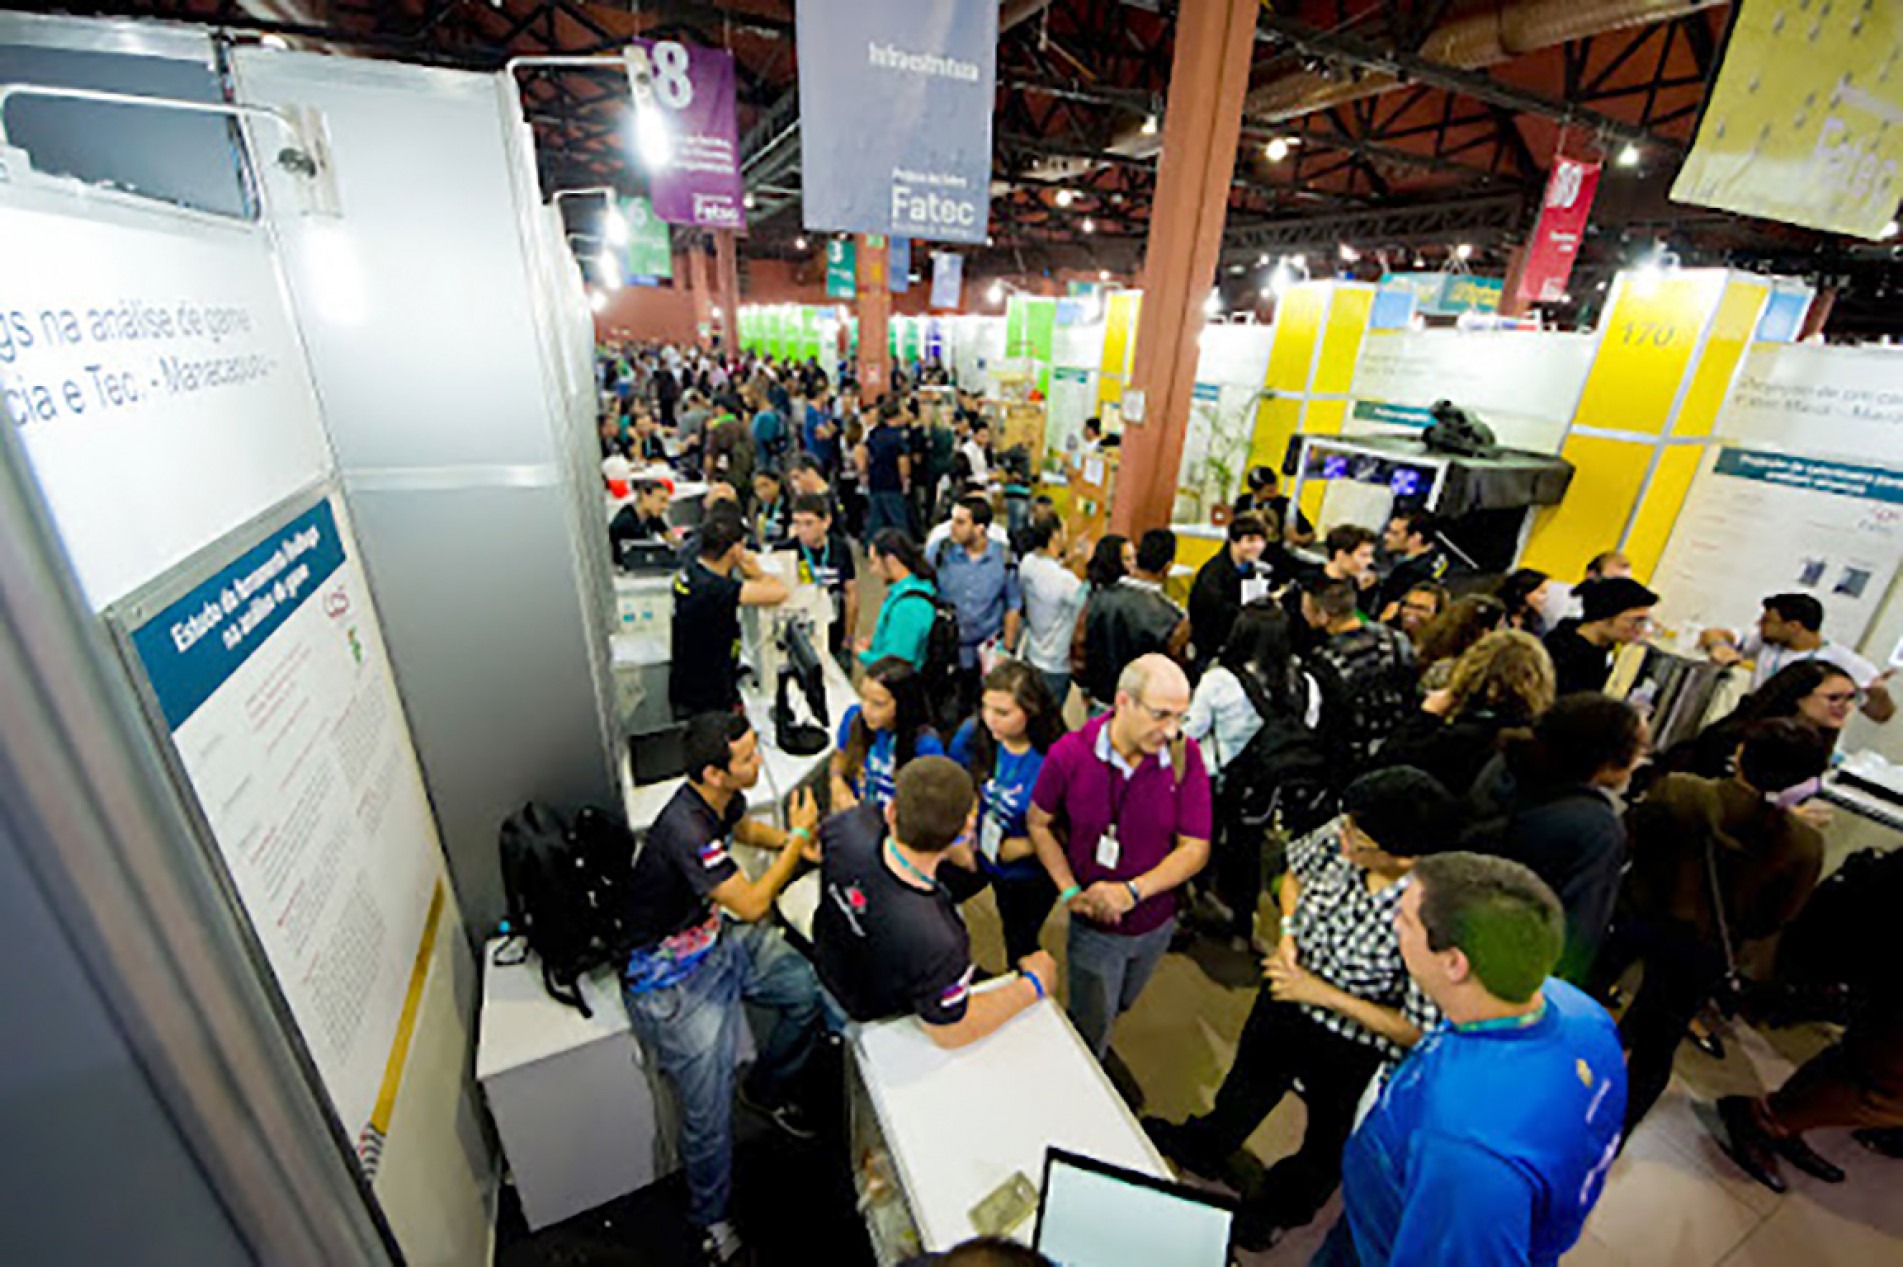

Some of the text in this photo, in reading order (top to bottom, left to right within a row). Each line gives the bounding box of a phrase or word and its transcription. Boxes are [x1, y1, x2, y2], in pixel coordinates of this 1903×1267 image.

[892, 186, 975, 226] Fatec
[39, 309, 82, 345] na
[87, 298, 175, 342] análise
[1621, 320, 1675, 346] 170
[62, 379, 85, 414] e
[169, 601, 224, 653] Estudo
